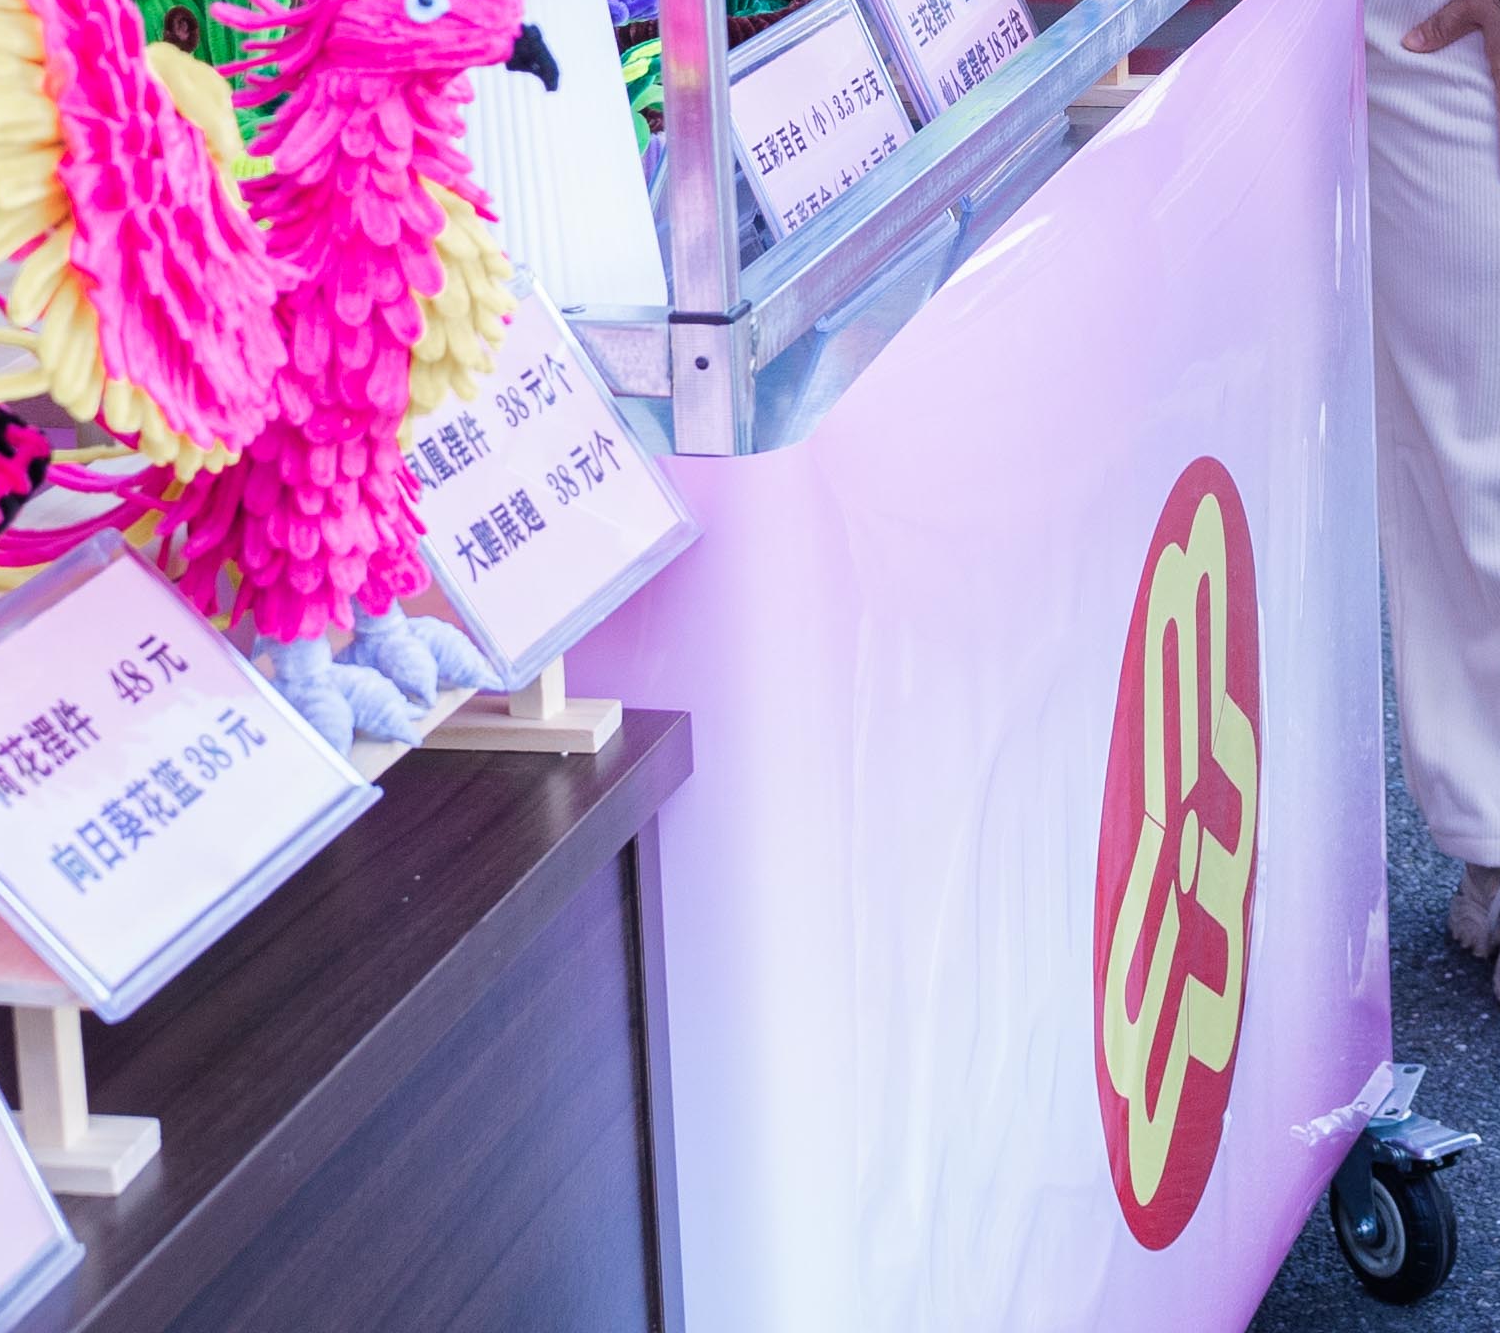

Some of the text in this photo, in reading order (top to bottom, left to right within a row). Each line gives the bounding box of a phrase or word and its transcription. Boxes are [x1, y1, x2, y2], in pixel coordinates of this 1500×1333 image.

[496, 353, 573, 428] 38元/个
[546, 429, 621, 506] 38元/个
[109, 634, 189, 704] 48元
